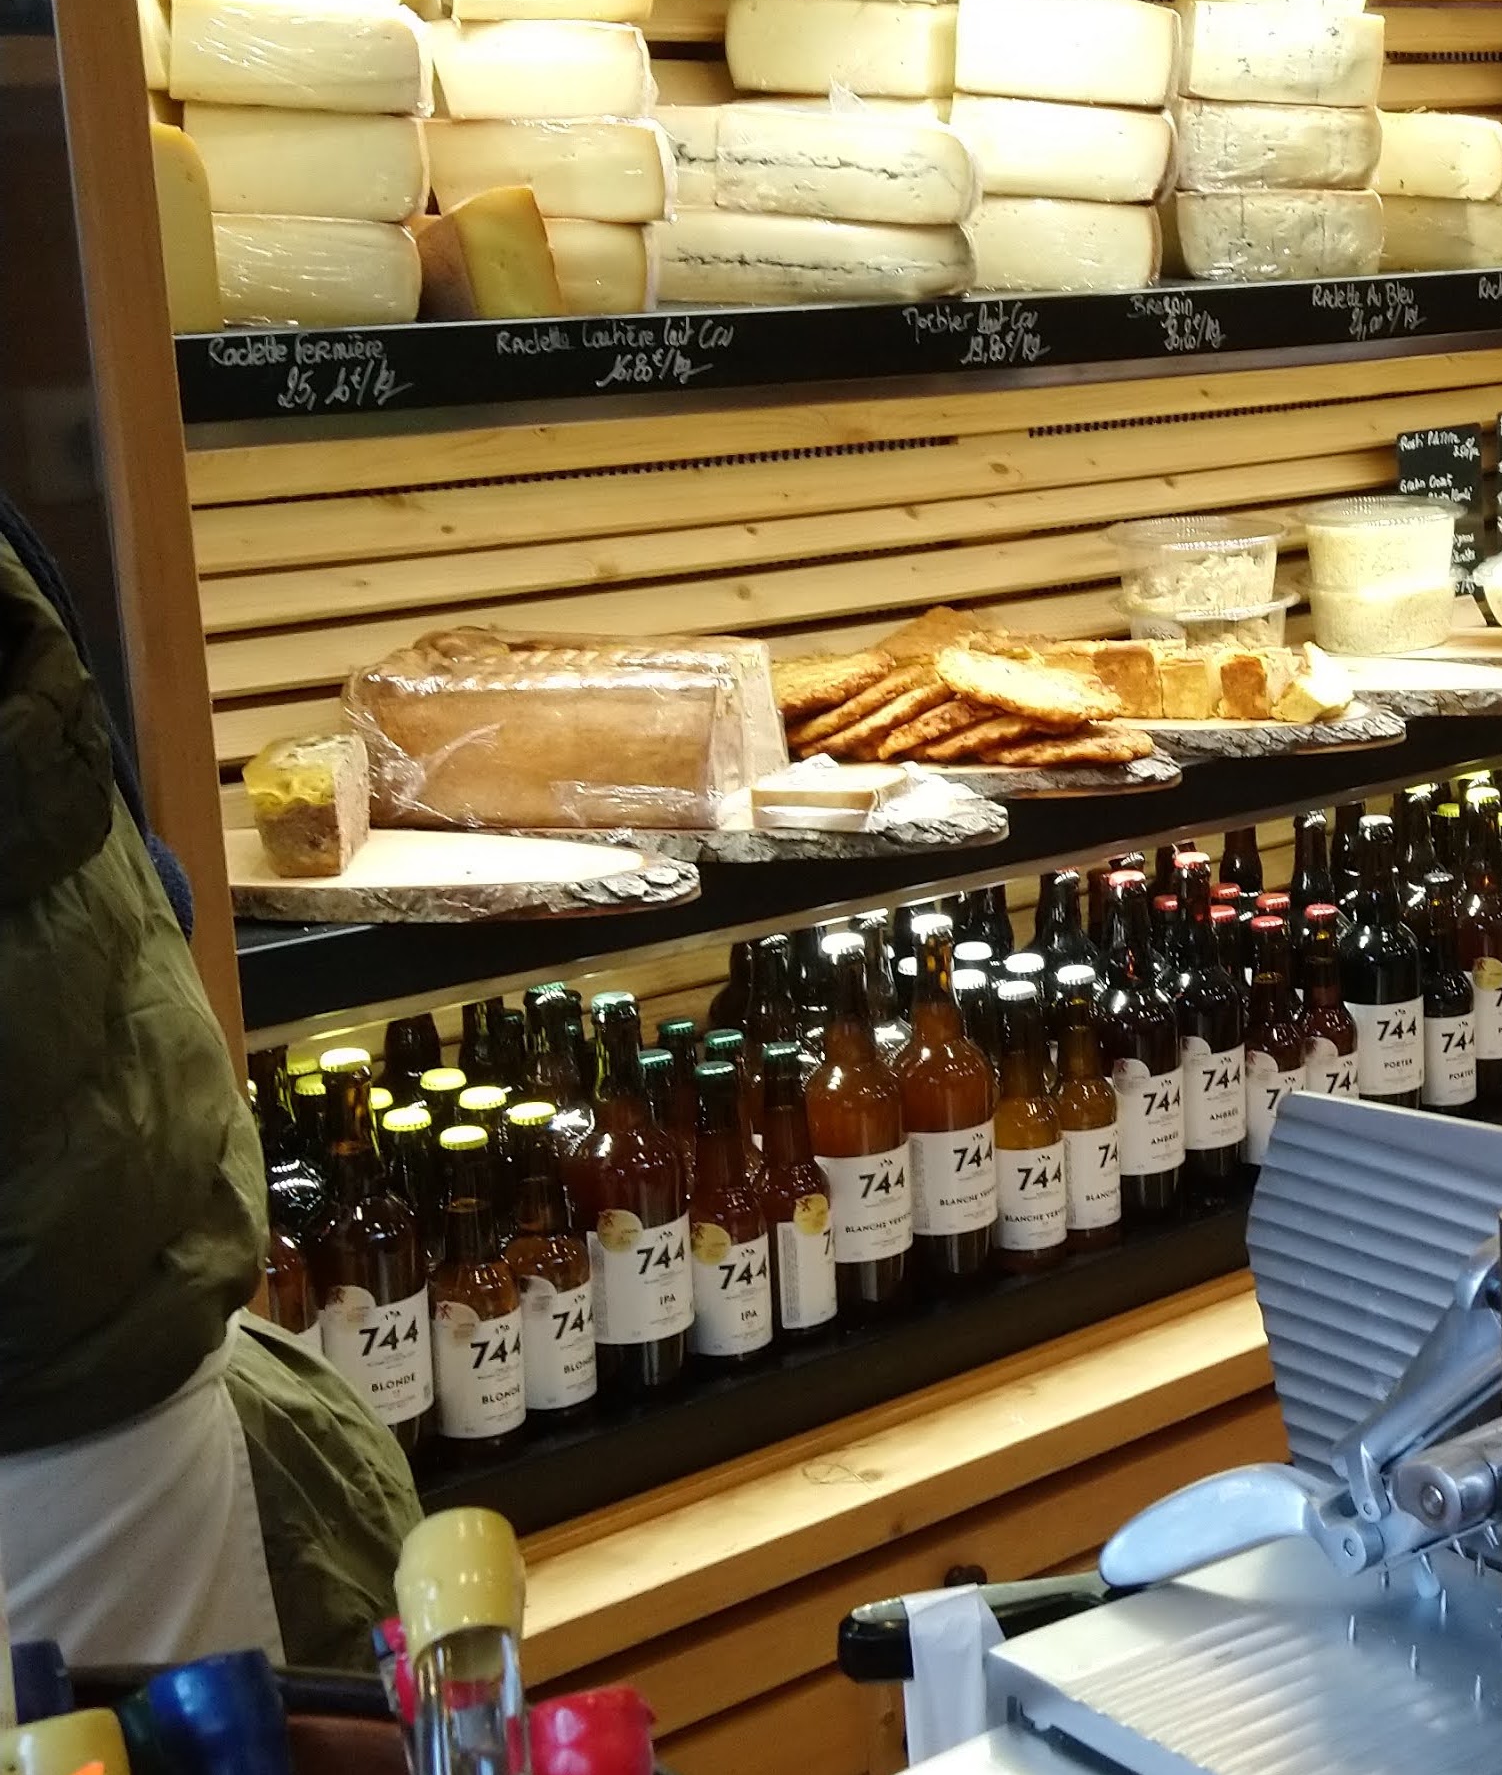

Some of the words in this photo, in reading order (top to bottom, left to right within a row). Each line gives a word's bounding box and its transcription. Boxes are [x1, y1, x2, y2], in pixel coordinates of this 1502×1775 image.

[1376, 1016, 1418, 1042] 744
[1442, 1029, 1476, 1054] 744
[1384, 1057, 1414, 1071] PORTER
[1202, 1064, 1242, 1093] 744
[1143, 1085, 1182, 1117] 744
[953, 1139, 994, 1173] 744
[1098, 1141, 1119, 1169] 74
[859, 1166, 906, 1200] 744
[1017, 1160, 1063, 1192] 744
[1085, 1187, 1119, 1202] BLANCH
[845, 1221, 888, 1234] BLANCHE
[1004, 1212, 1044, 1223] BLANCHE
[636, 1236, 686, 1276] 744
[718, 1255, 768, 1290] 744
[659, 1293, 677, 1306] IPA
[740, 1309, 758, 1322] IPA
[359, 1315, 420, 1357] 744
[469, 1332, 522, 1370] 744
[371, 1372, 417, 1393] BLONDE
[481, 1383, 522, 1405] BLONDE
